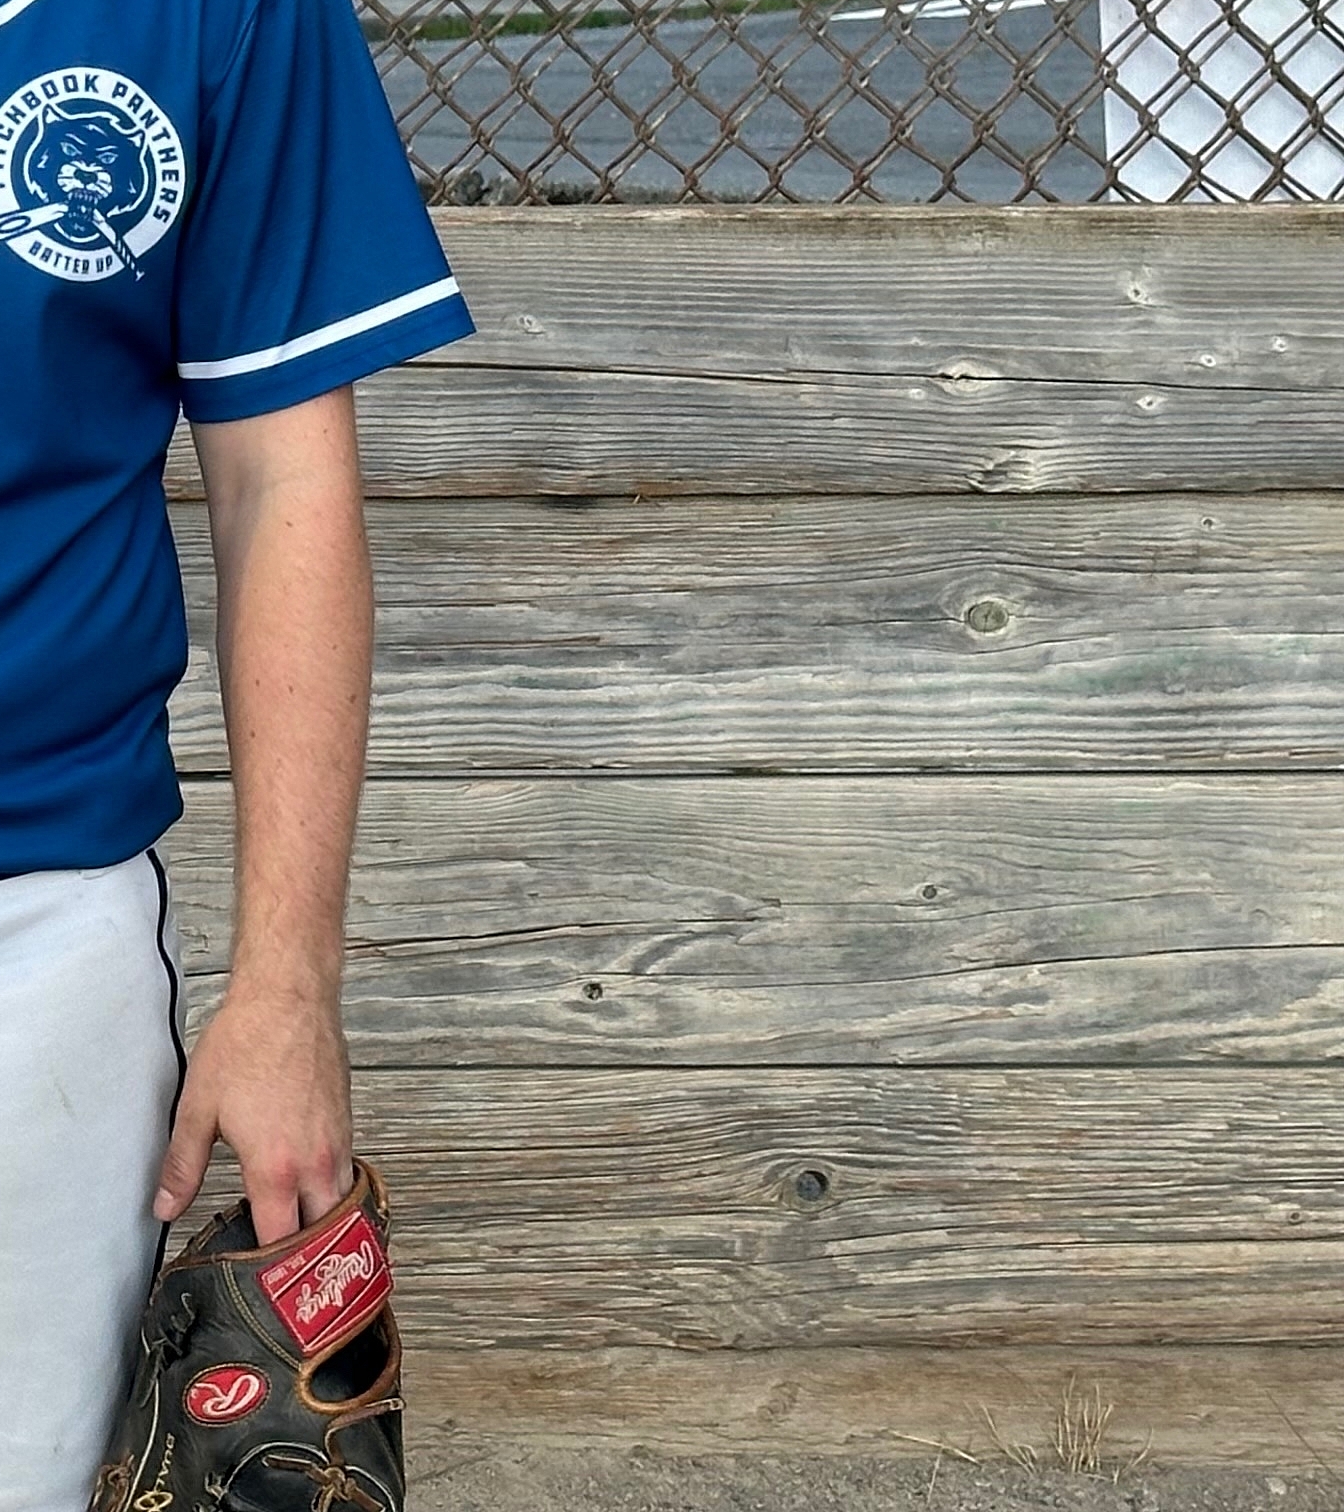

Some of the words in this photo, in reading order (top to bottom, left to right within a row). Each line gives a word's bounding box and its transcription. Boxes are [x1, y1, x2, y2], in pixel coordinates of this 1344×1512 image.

[111, 80, 180, 224] PANTHERS
[28, 240, 90, 275] BATTER
[95, 254, 114, 274] UP
[294, 1239, 375, 1325] Rawlings
